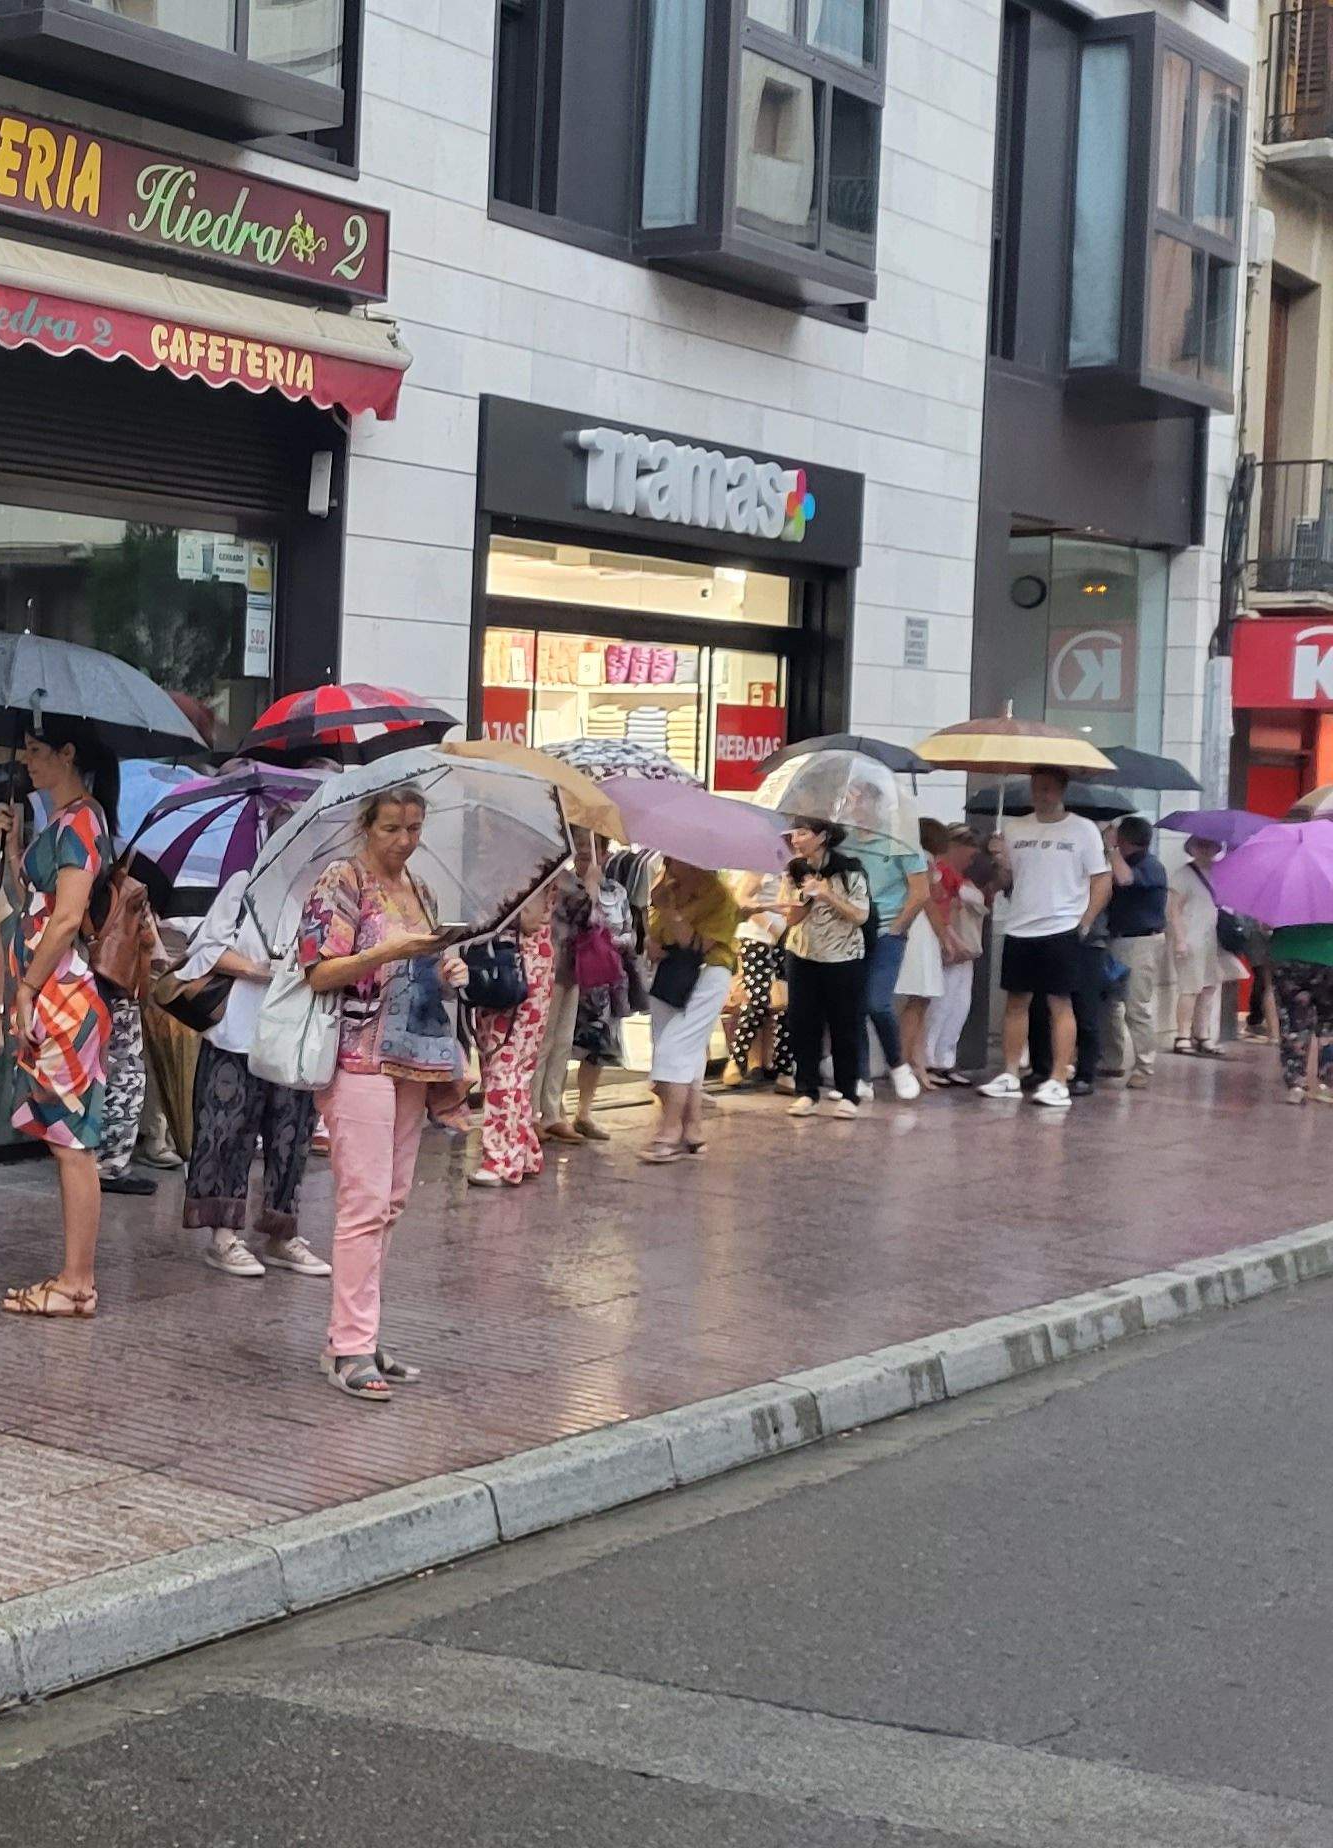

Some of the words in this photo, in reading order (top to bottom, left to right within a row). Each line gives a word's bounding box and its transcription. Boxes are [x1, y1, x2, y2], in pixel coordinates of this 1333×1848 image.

[128, 163, 288, 266] Hiedra
[330, 214, 369, 281] 2
[92, 316, 114, 347] 2
[150, 323, 315, 392] CAFETERIA
